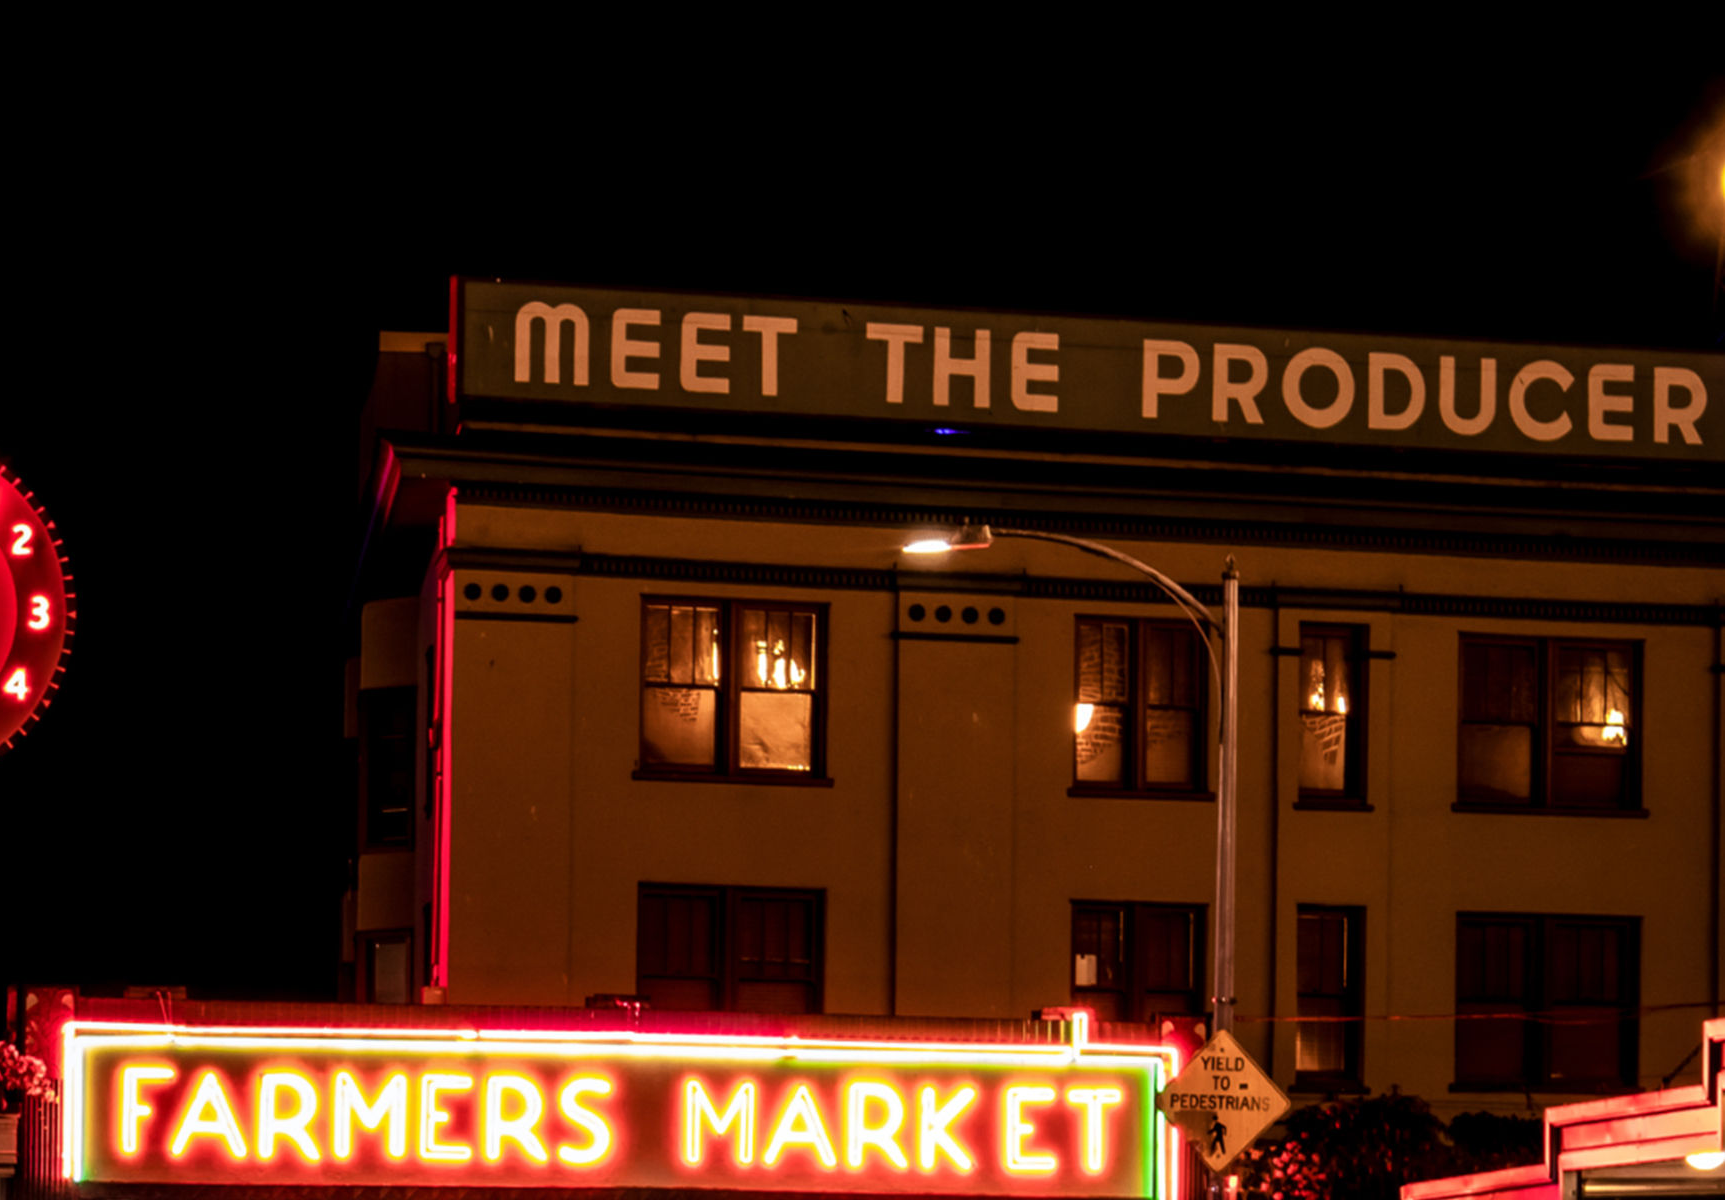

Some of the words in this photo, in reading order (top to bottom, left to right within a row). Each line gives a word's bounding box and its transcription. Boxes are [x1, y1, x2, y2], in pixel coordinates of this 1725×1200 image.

[515, 301, 797, 396] MEET
[866, 322, 1059, 412] THE
[1142, 339, 1707, 445] PRODUCER
[11, 524, 33, 555] 2
[28, 596, 50, 630] 3
[3, 667, 29, 700] 4
[1201, 1056, 1245, 1071] YIELD
[1213, 1075, 1230, 1091] TO
[118, 1064, 613, 1165] FARMERS
[680, 1078, 1124, 1172] MARKET
[1170, 1093, 1270, 1112] PEDESTRIANS
